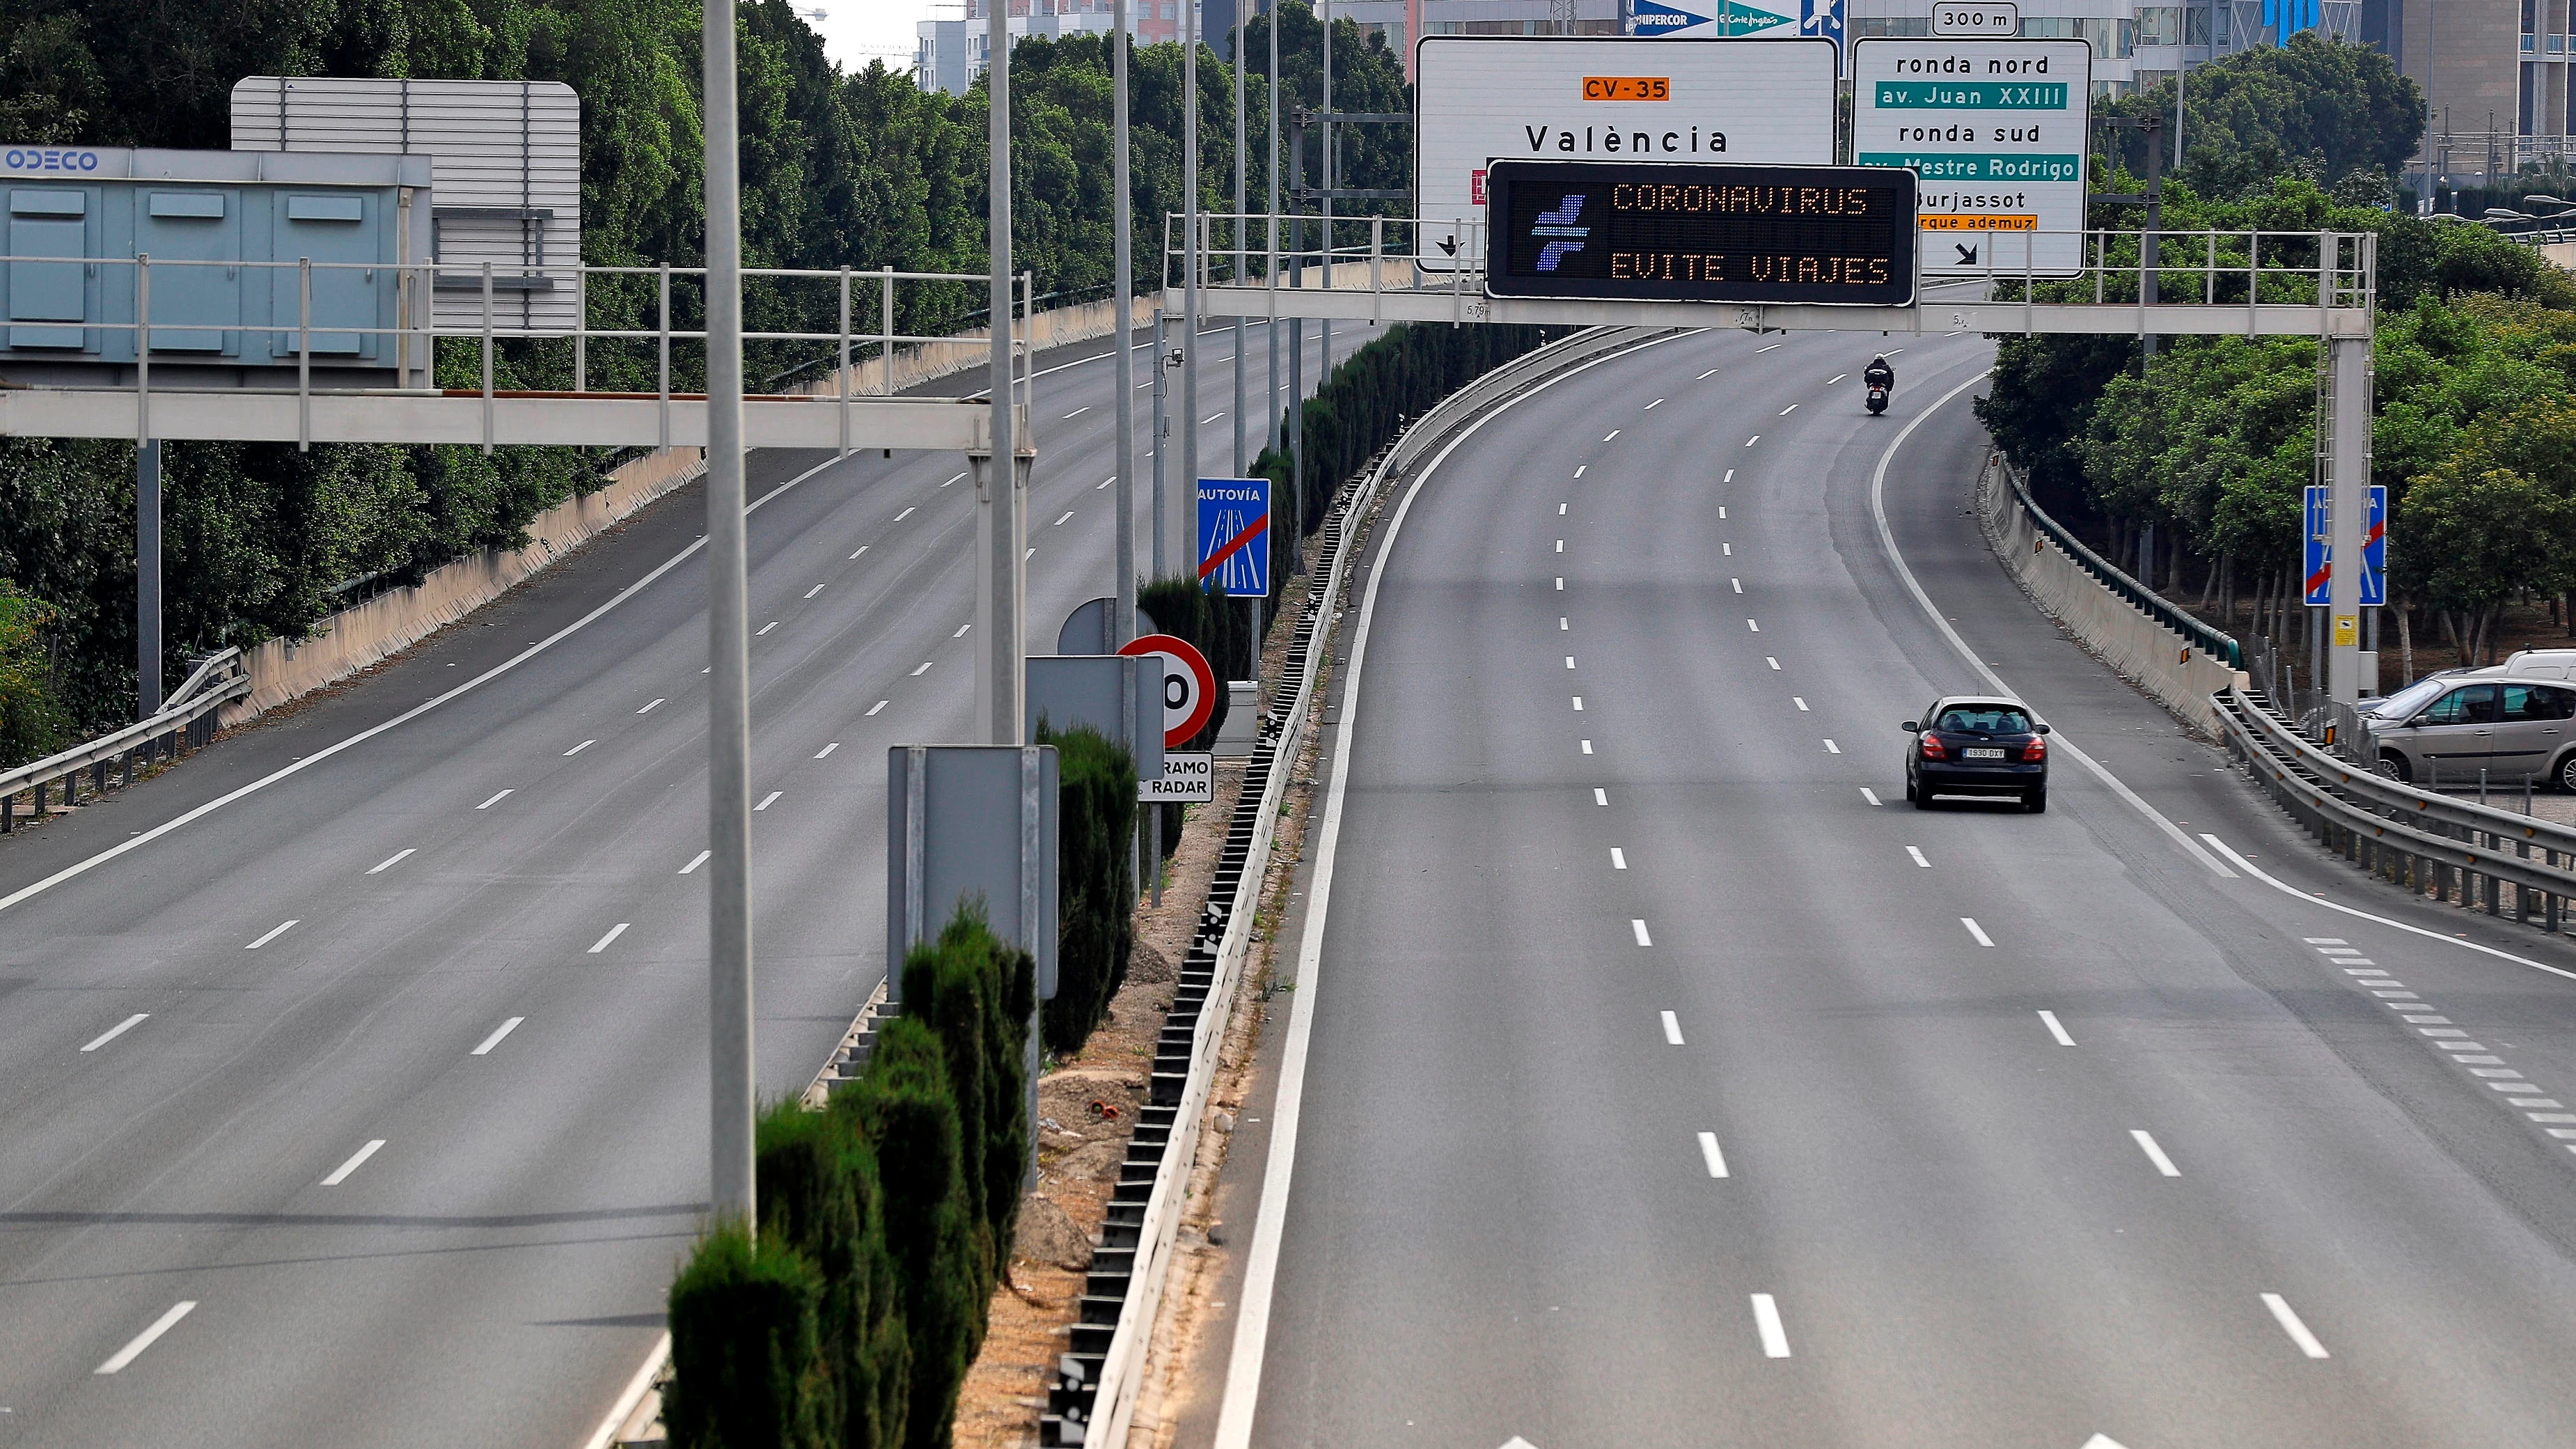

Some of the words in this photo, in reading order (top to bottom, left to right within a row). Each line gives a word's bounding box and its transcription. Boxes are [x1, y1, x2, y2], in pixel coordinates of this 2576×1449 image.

[1638, 14, 1688, 26] HIPERCOR
[1943, 13, 1984, 26] 300
[1993, 16, 2007, 26] m
[1896, 56, 1970, 74] ronda
[1988, 56, 2048, 74] nord
[1585, 81, 1666, 98] CV-35
[1883, 91, 1913, 104] av.
[1924, 87, 1981, 104] Juan
[1999, 88, 2059, 104] XXIII
[1525, 125, 1727, 152] València
[1899, 125, 1974, 142] ronda
[1993, 125, 2040, 142] sud
[6, 149, 98, 171] ODECO
[1989, 159, 2074, 180] Rodrigo
[1613, 184, 1867, 214] CORONAVIRUS
[1921, 219, 1958, 230] rque
[1968, 218, 2034, 229] ademuz
[1612, 253, 1724, 281] EVITE
[1752, 256, 1889, 284] VIAJES
[1197, 487, 1261, 501] AUTOVÍA
[1164, 673, 1190, 710] 0
[1164, 761, 1209, 774] RAMO
[1152, 781, 1207, 794] RADAR
